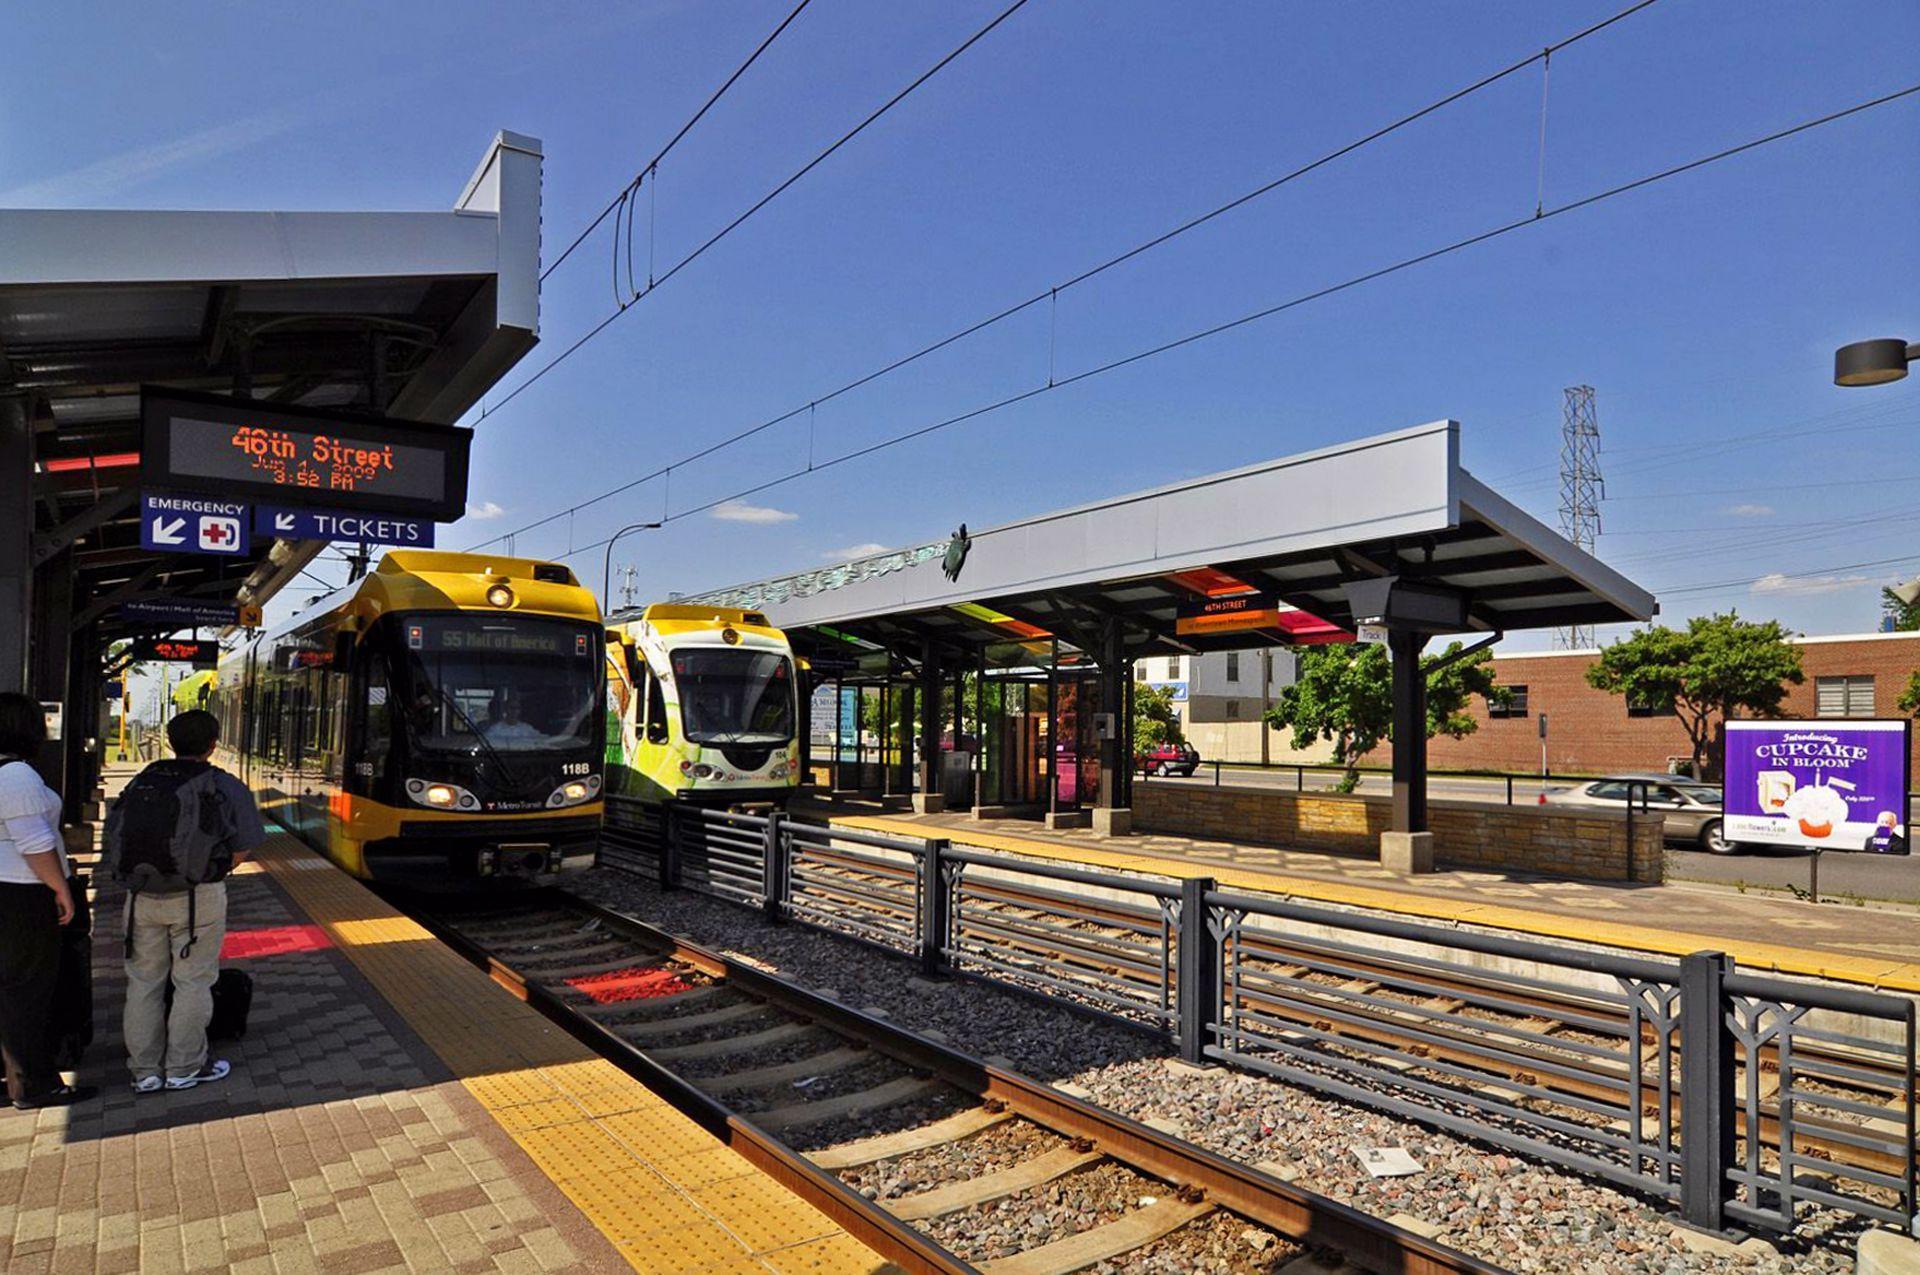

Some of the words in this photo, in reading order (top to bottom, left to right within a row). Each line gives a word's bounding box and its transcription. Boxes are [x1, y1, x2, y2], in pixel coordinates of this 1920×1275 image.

[232, 425, 296, 459] 46th
[312, 435, 394, 470] Street
[273, 469, 320, 488] 3:52
[330, 471, 354, 491] PM
[148, 496, 245, 516] EMERGENCY
[313, 514, 420, 542] TICKETS
[138, 602, 169, 612] Airport
[202, 607, 236, 616] America
[1222, 599, 1247, 610] STREET
[442, 630, 462, 647] 55
[466, 631, 491, 647] Mall
[511, 634, 556, 650] America
[1362, 628, 1381, 640] Track
[1782, 732, 1839, 744] Introducing
[1755, 742, 1868, 760] CUPCAKE
[561, 763, 590, 775] 118B
[1772, 757, 1788, 767] IN
